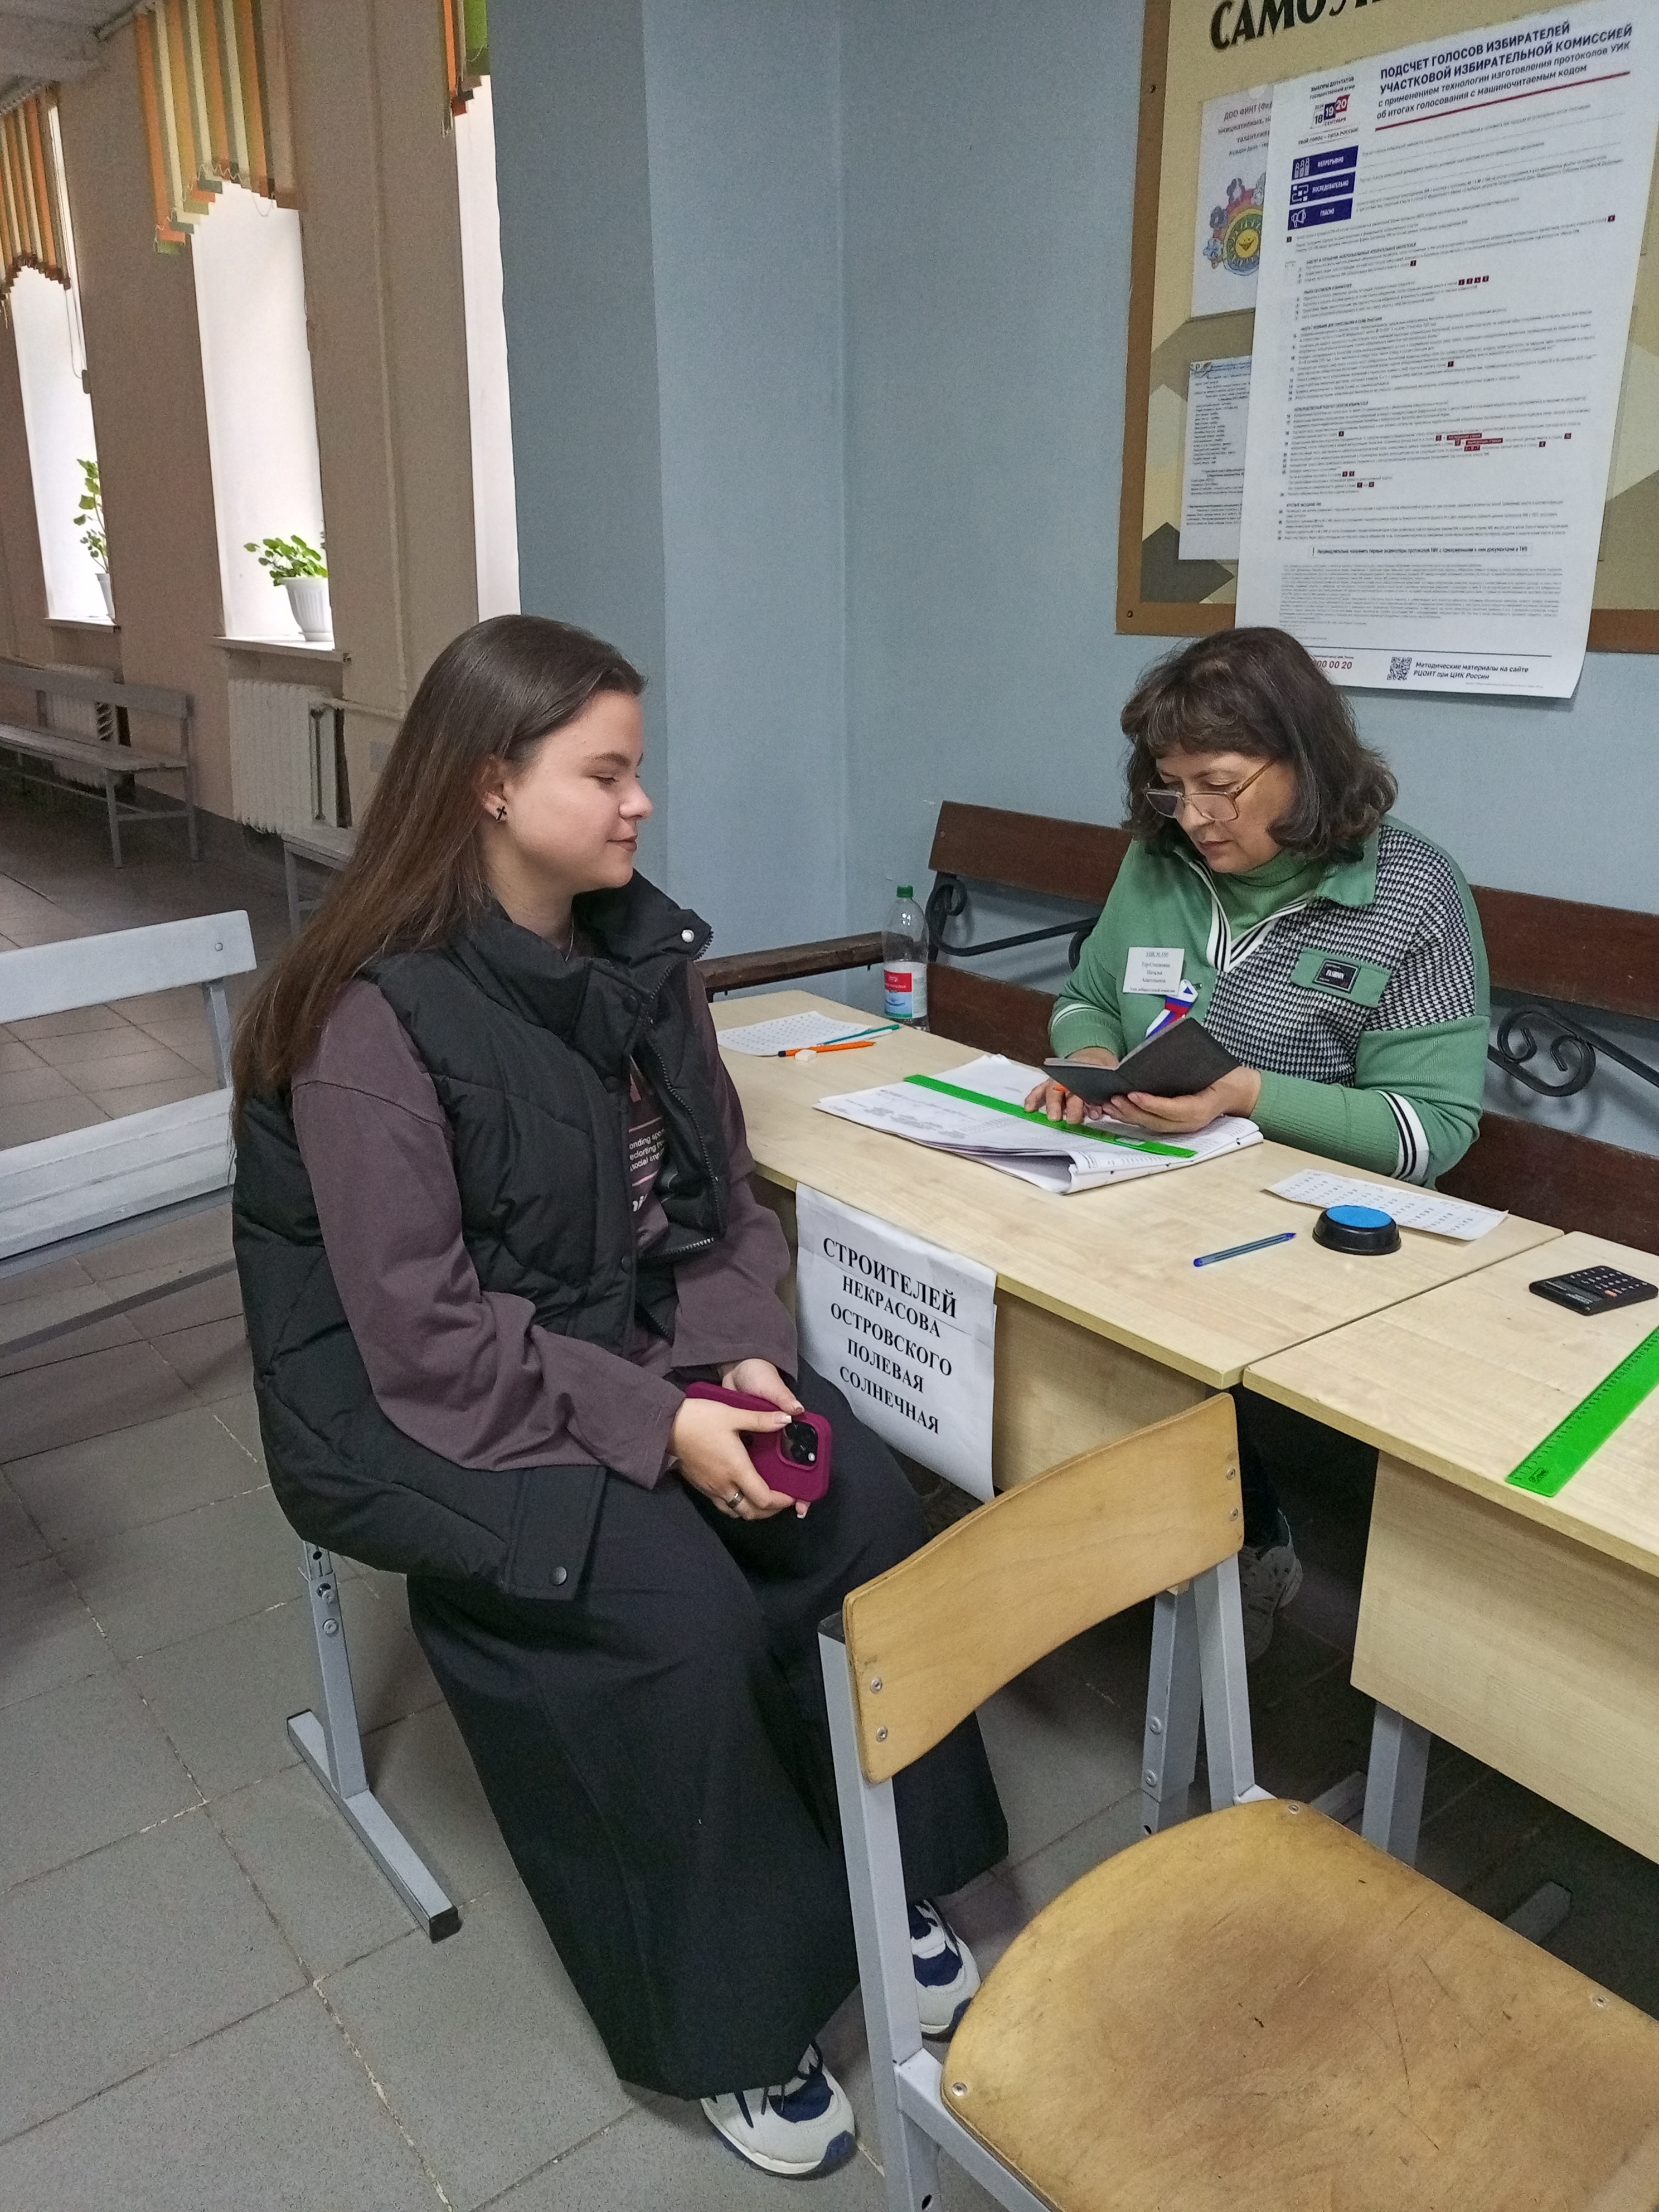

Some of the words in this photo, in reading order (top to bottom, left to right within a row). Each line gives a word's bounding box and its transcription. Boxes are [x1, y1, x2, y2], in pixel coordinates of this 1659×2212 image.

[1210, 0, 1384, 51] САМО
[1380, 57, 1429, 80] ПОДСЧЕТ
[1432, 44, 1484, 66] ГОЛОСОВ
[1486, 18, 1570, 53] ИЗБИРАТЕЛЕЙ
[1380, 66, 1451, 95] УЧАСТКОВОЙ
[1453, 41, 1553, 77] ИЗБИРАТЕЛЬНОЙ
[1555, 23, 1633, 52] КОМИССИЕЙ
[1384, 86, 1439, 107] применением
[1441, 74, 1490, 92] технологии
[1491, 60, 1552, 81] изготовления
[1554, 47, 1608, 67] протоколов
[1611, 40, 1632, 53] УИК
[1315, 114, 1323, 124] 18
[1325, 106, 1334, 117] 19
[1335, 99, 1347, 110] 20
[1376, 110, 1386, 120] об
[1388, 104, 1414, 117] итогах
[1416, 91, 1468, 111] голосования
[1477, 71, 1556, 96] машиночитаемым
[1558, 65, 1587, 79] кодом
[1313, 659, 1327, 668] 00
[1341, 661, 1352, 670] 20
[1415, 662, 1461, 670] Методические
[823, 1237, 957, 1320] СТРОИТЕЛЕЙ
[842, 1275, 941, 1338] НЕКРАСОВА
[831, 1303, 953, 1376] ОСТРОВСКОГО
[847, 1338, 924, 1394] ПОЛЕВАЯ
[840, 1366, 940, 1435] СОЛНЕЧНАЯ
